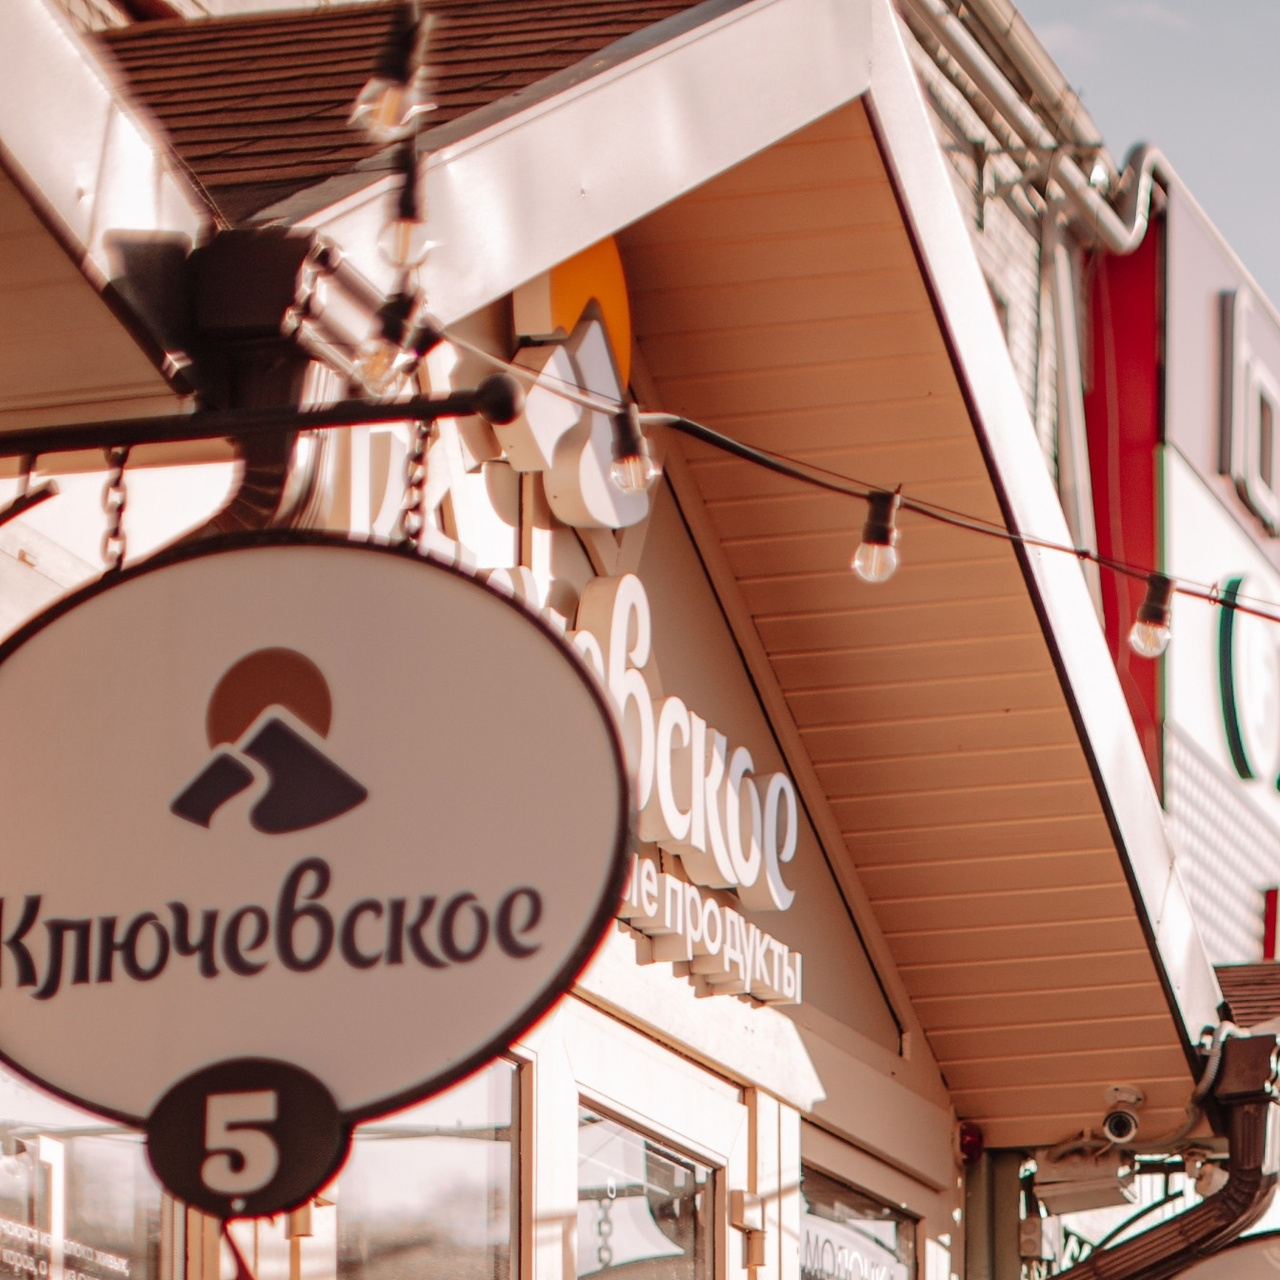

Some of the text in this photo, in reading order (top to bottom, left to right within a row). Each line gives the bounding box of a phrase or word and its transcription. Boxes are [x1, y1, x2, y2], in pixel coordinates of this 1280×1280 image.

[0, 858, 543, 1000] Ключевское
[664, 873, 802, 1004] продукты
[202, 1090, 279, 1196] 5
